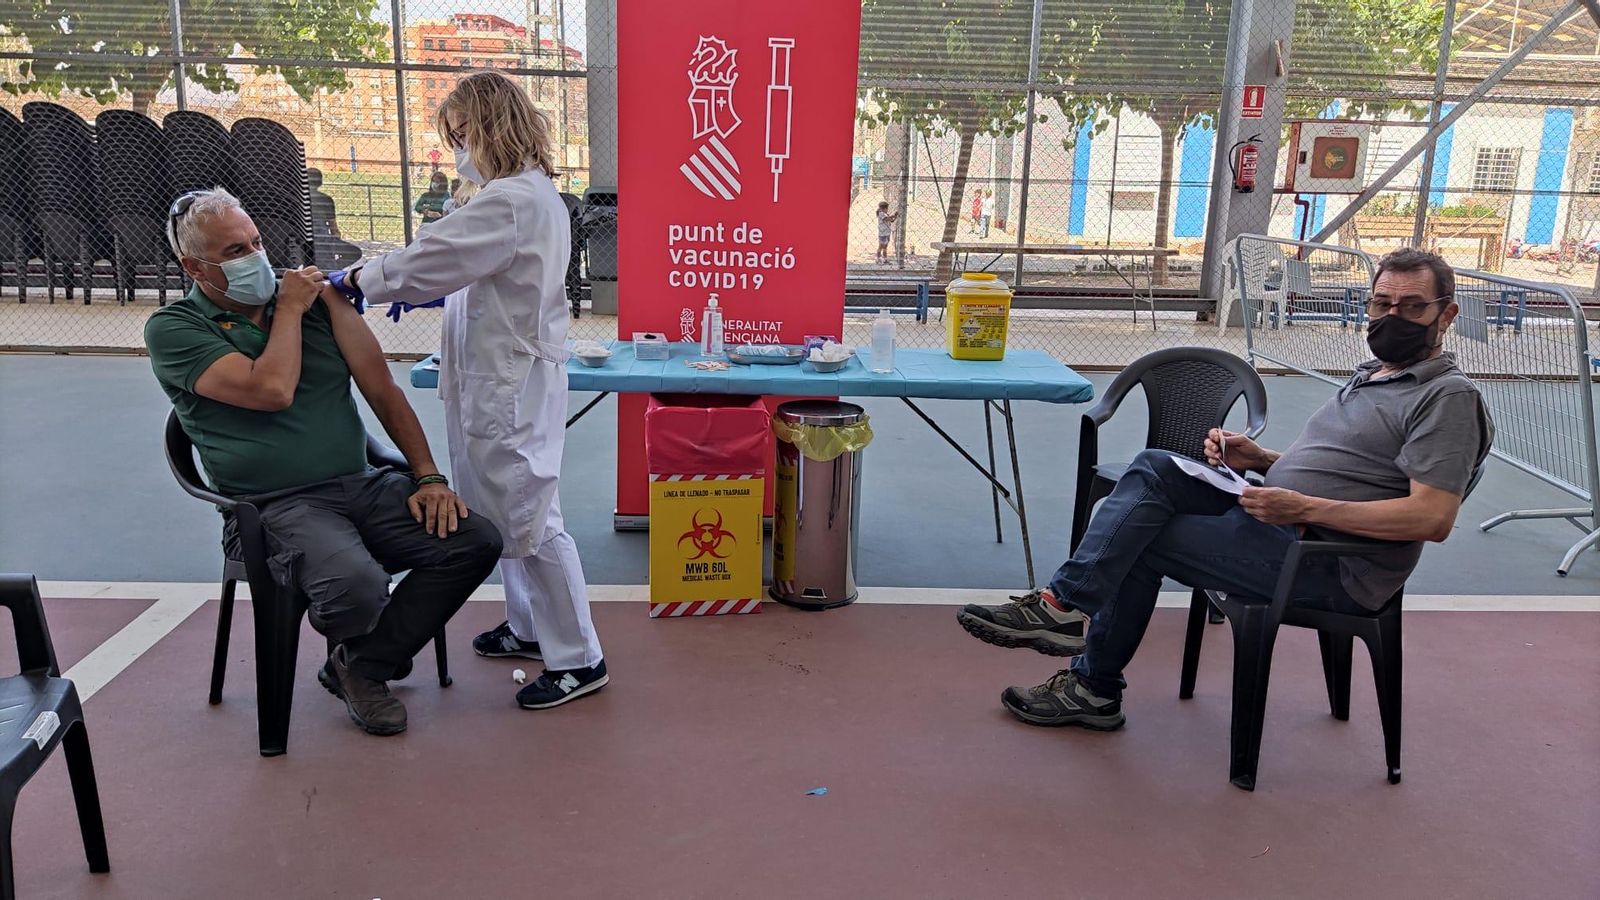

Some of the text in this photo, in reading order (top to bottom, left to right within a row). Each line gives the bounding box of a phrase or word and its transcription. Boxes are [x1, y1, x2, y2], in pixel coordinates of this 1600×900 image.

[668, 222, 763, 246] punt de
[668, 247, 796, 269] vacunació
[668, 270, 764, 290] COVID19
[701, 320, 783, 332] NERALITAT
[724, 332, 780, 344] ENCIANA
[687, 489, 709, 497] LLENADO
[685, 562, 709, 574] MWB
